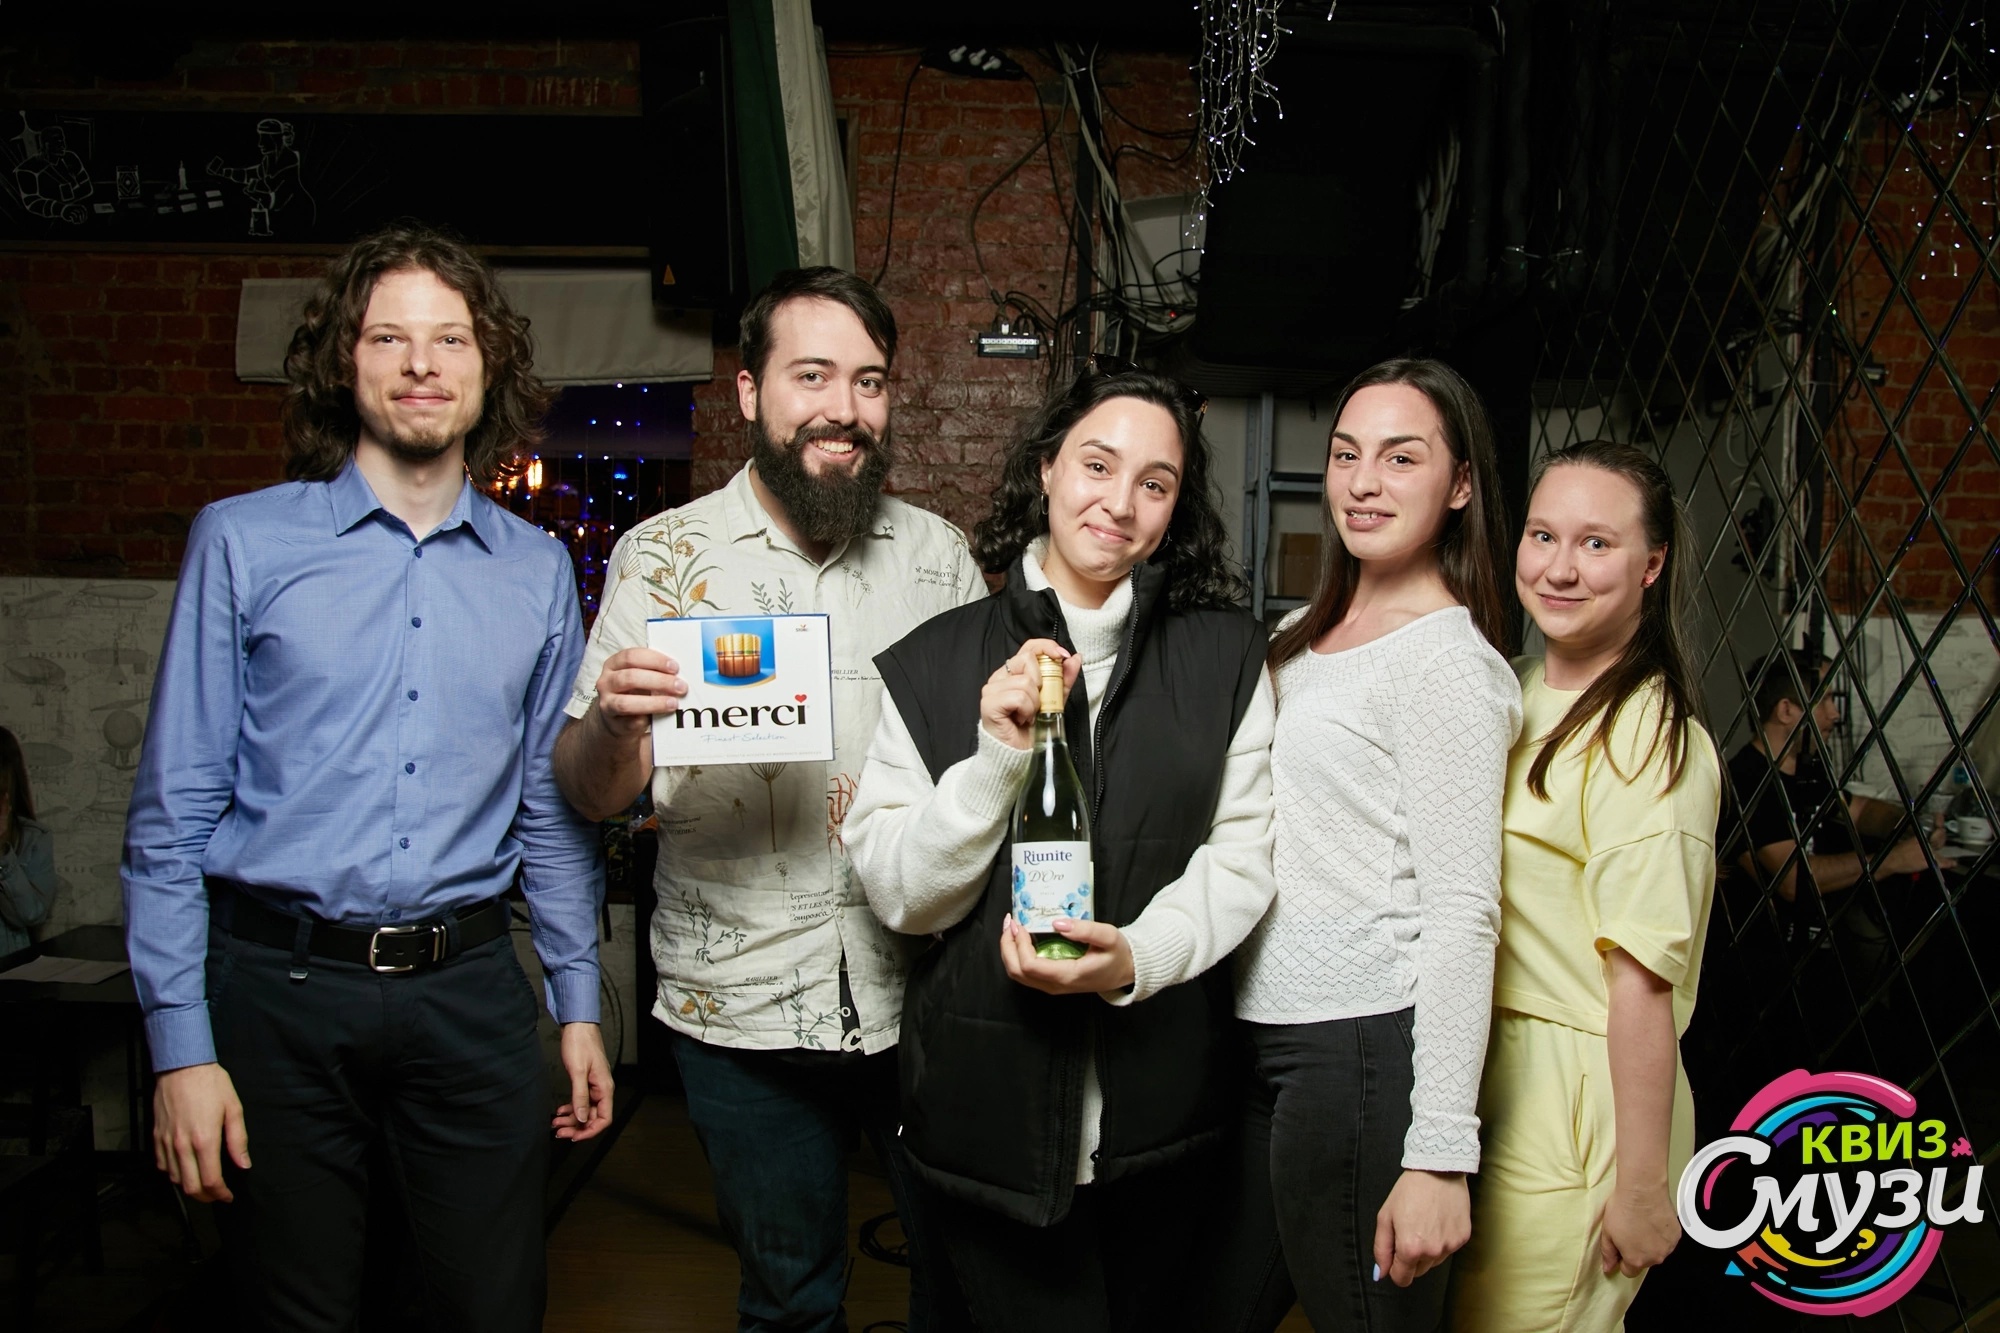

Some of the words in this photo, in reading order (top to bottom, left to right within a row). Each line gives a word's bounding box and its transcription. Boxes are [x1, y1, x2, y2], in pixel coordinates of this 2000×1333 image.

[676, 693, 808, 729] merci
[700, 734, 739, 744] Finest
[741, 732, 787, 743] Selection
[1023, 850, 1073, 866] Riunite
[1028, 869, 1065, 883] D'Oro
